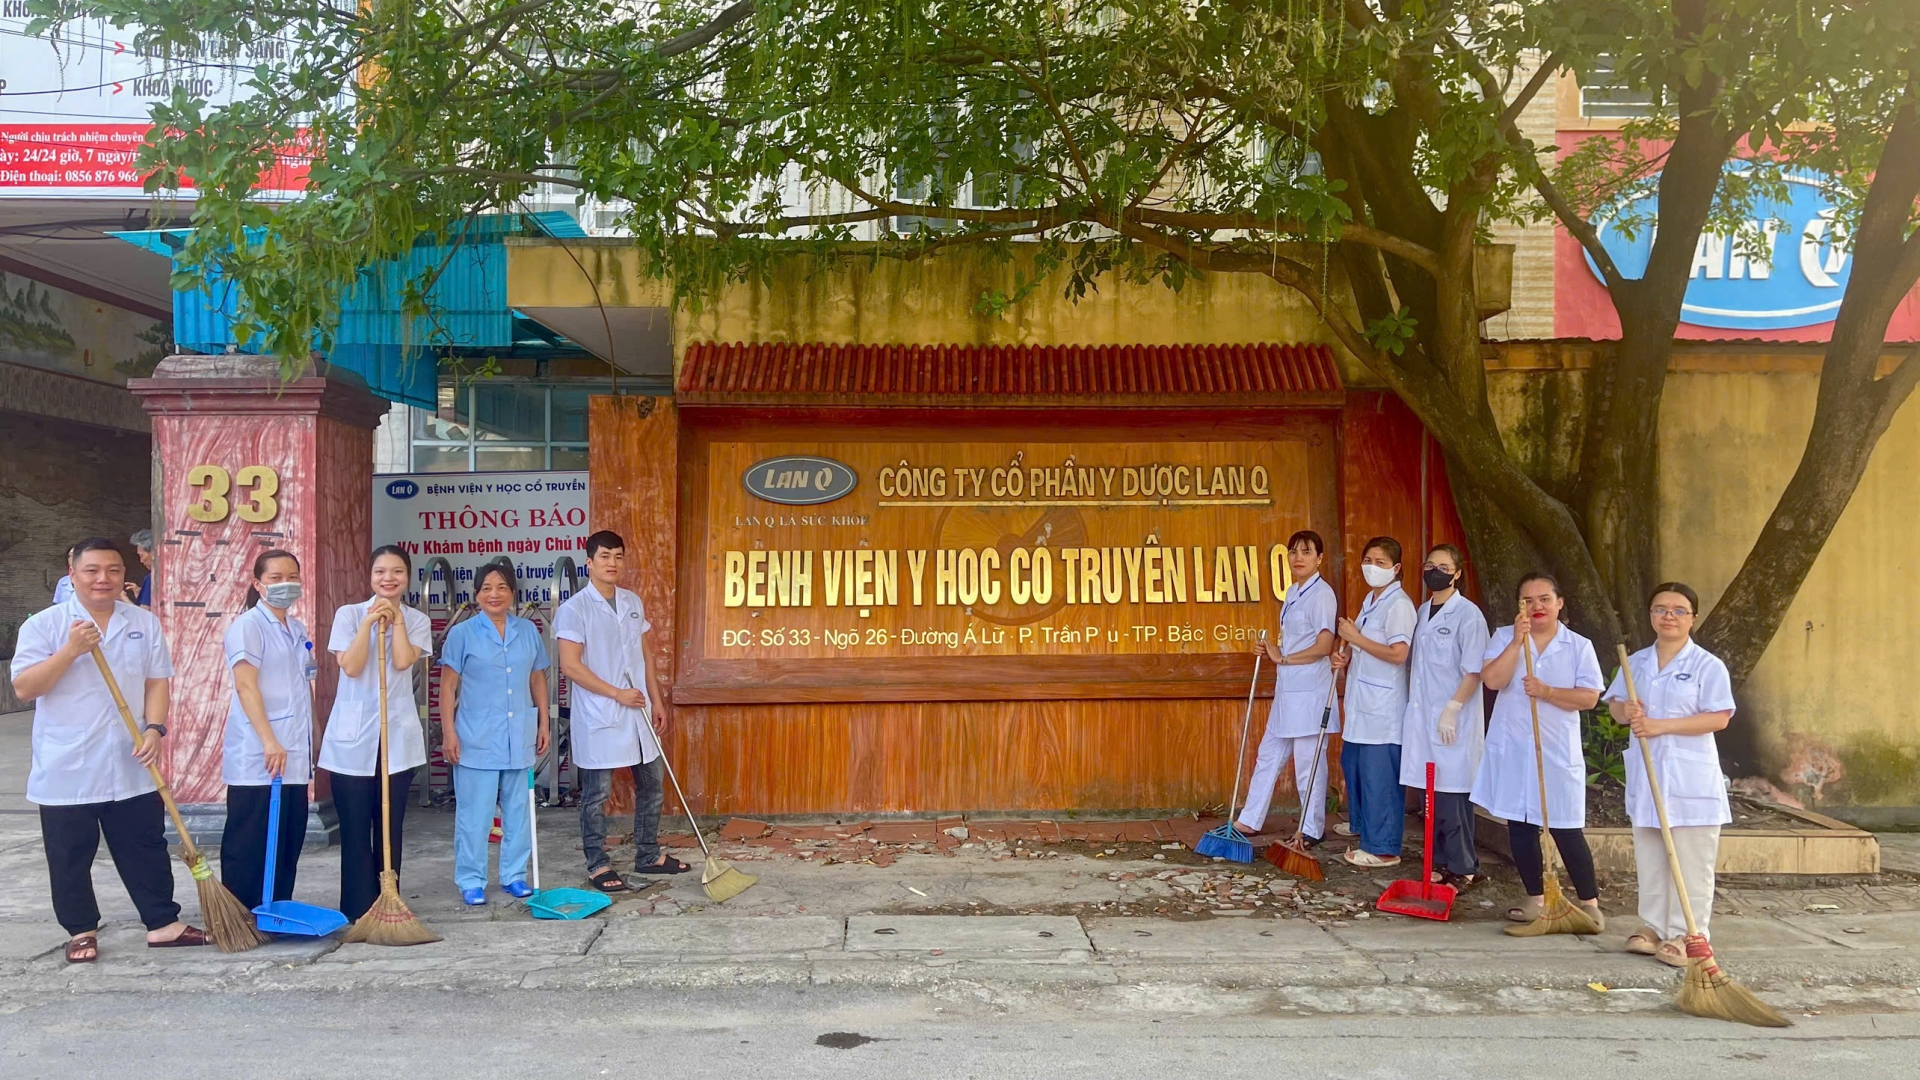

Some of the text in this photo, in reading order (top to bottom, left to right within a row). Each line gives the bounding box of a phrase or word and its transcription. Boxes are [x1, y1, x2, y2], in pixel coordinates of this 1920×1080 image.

[133, 78, 170, 96] KHOA
[53, 132, 77, 142] trách
[80, 132, 108, 144] nhiệm
[110, 132, 144, 145] chuyên
[23, 149, 57, 162] 24/24
[60, 149, 83, 165] giờ,
[86, 149, 94, 161] 7
[30, 170, 62, 185] thoại:
[65, 170, 92, 182] 0856
[95, 170, 115, 182] 876
[426, 483, 455, 497] BỆNH
[459, 482, 482, 496] VIỆN
[486, 484, 493, 493] Y
[497, 483, 522, 495] HỌC
[525, 478, 543, 492] CỔ
[764, 467, 834, 491] LAN Q
[879, 459, 947, 497] CÔNG
[953, 468, 986, 497] TY
[990, 450, 1025, 497] CỔ
[1098, 467, 1116, 496] Y
[1122, 463, 1191, 505] DƯỢC
[1196, 466, 1246, 496] LAN
[1250, 465, 1270, 496] Q
[187, 465, 279, 523] 33
[419, 502, 586, 530] THÔNG BÁO
[735, 515, 761, 526] LAN
[764, 515, 776, 528] Q
[424, 539, 463, 555] Khám
[468, 538, 503, 558] bệnh
[507, 538, 541, 556] ngày
[545, 534, 573, 552] Chủ
[906, 549, 927, 606] Y
[1193, 545, 1261, 603] LAN
[722, 628, 757, 647] ĐC:
[760, 626, 785, 646] Số
[788, 628, 811, 646] 33
[824, 628, 860, 649] Ngõ
[865, 627, 888, 646] 26
[900, 627, 959, 649] Đường
[963, 622, 977, 645] Á
[1019, 626, 1034, 644] P.
[1041, 624, 1082, 644] Trần
[1131, 625, 1163, 643] TP.
[1168, 621, 1204, 642] Bắc
